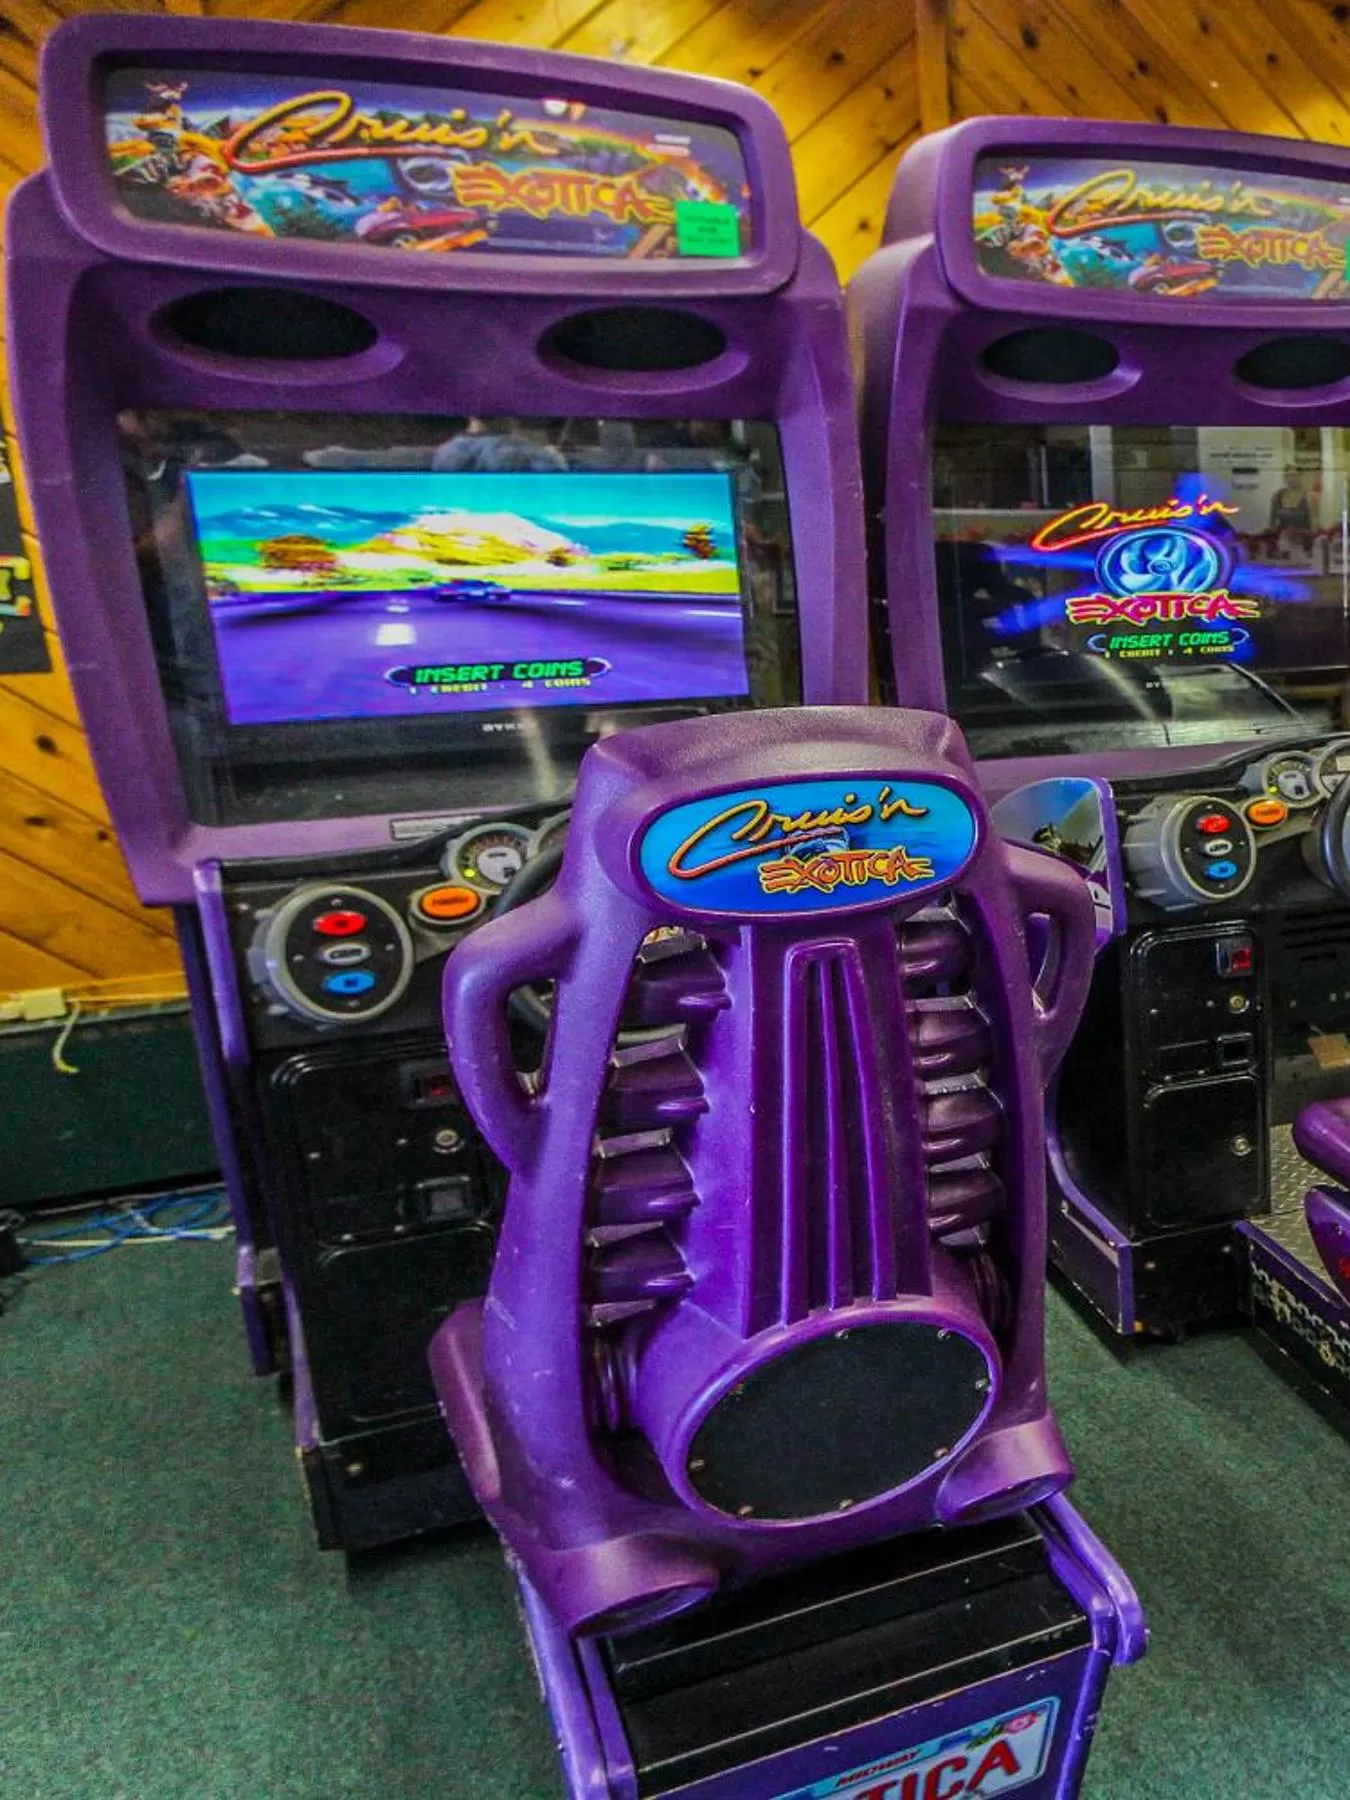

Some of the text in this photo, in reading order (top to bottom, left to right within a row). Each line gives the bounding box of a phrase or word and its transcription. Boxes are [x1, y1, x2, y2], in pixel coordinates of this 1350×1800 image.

[223, 90, 559, 173] Cruis'n
[449, 161, 674, 225] EXOTICA
[1047, 168, 1273, 238] Cruis'n
[1196, 222, 1346, 272] EXOTICA
[1031, 495, 1240, 551] Cruis'n
[1066, 589, 1261, 627] EXOTICA
[1109, 630, 1231, 650] INSERT COINS
[414, 660, 584, 684] INSERT COINS
[668, 786, 929, 880] Cruis'n
[757, 845, 935, 894] EXOTICA
